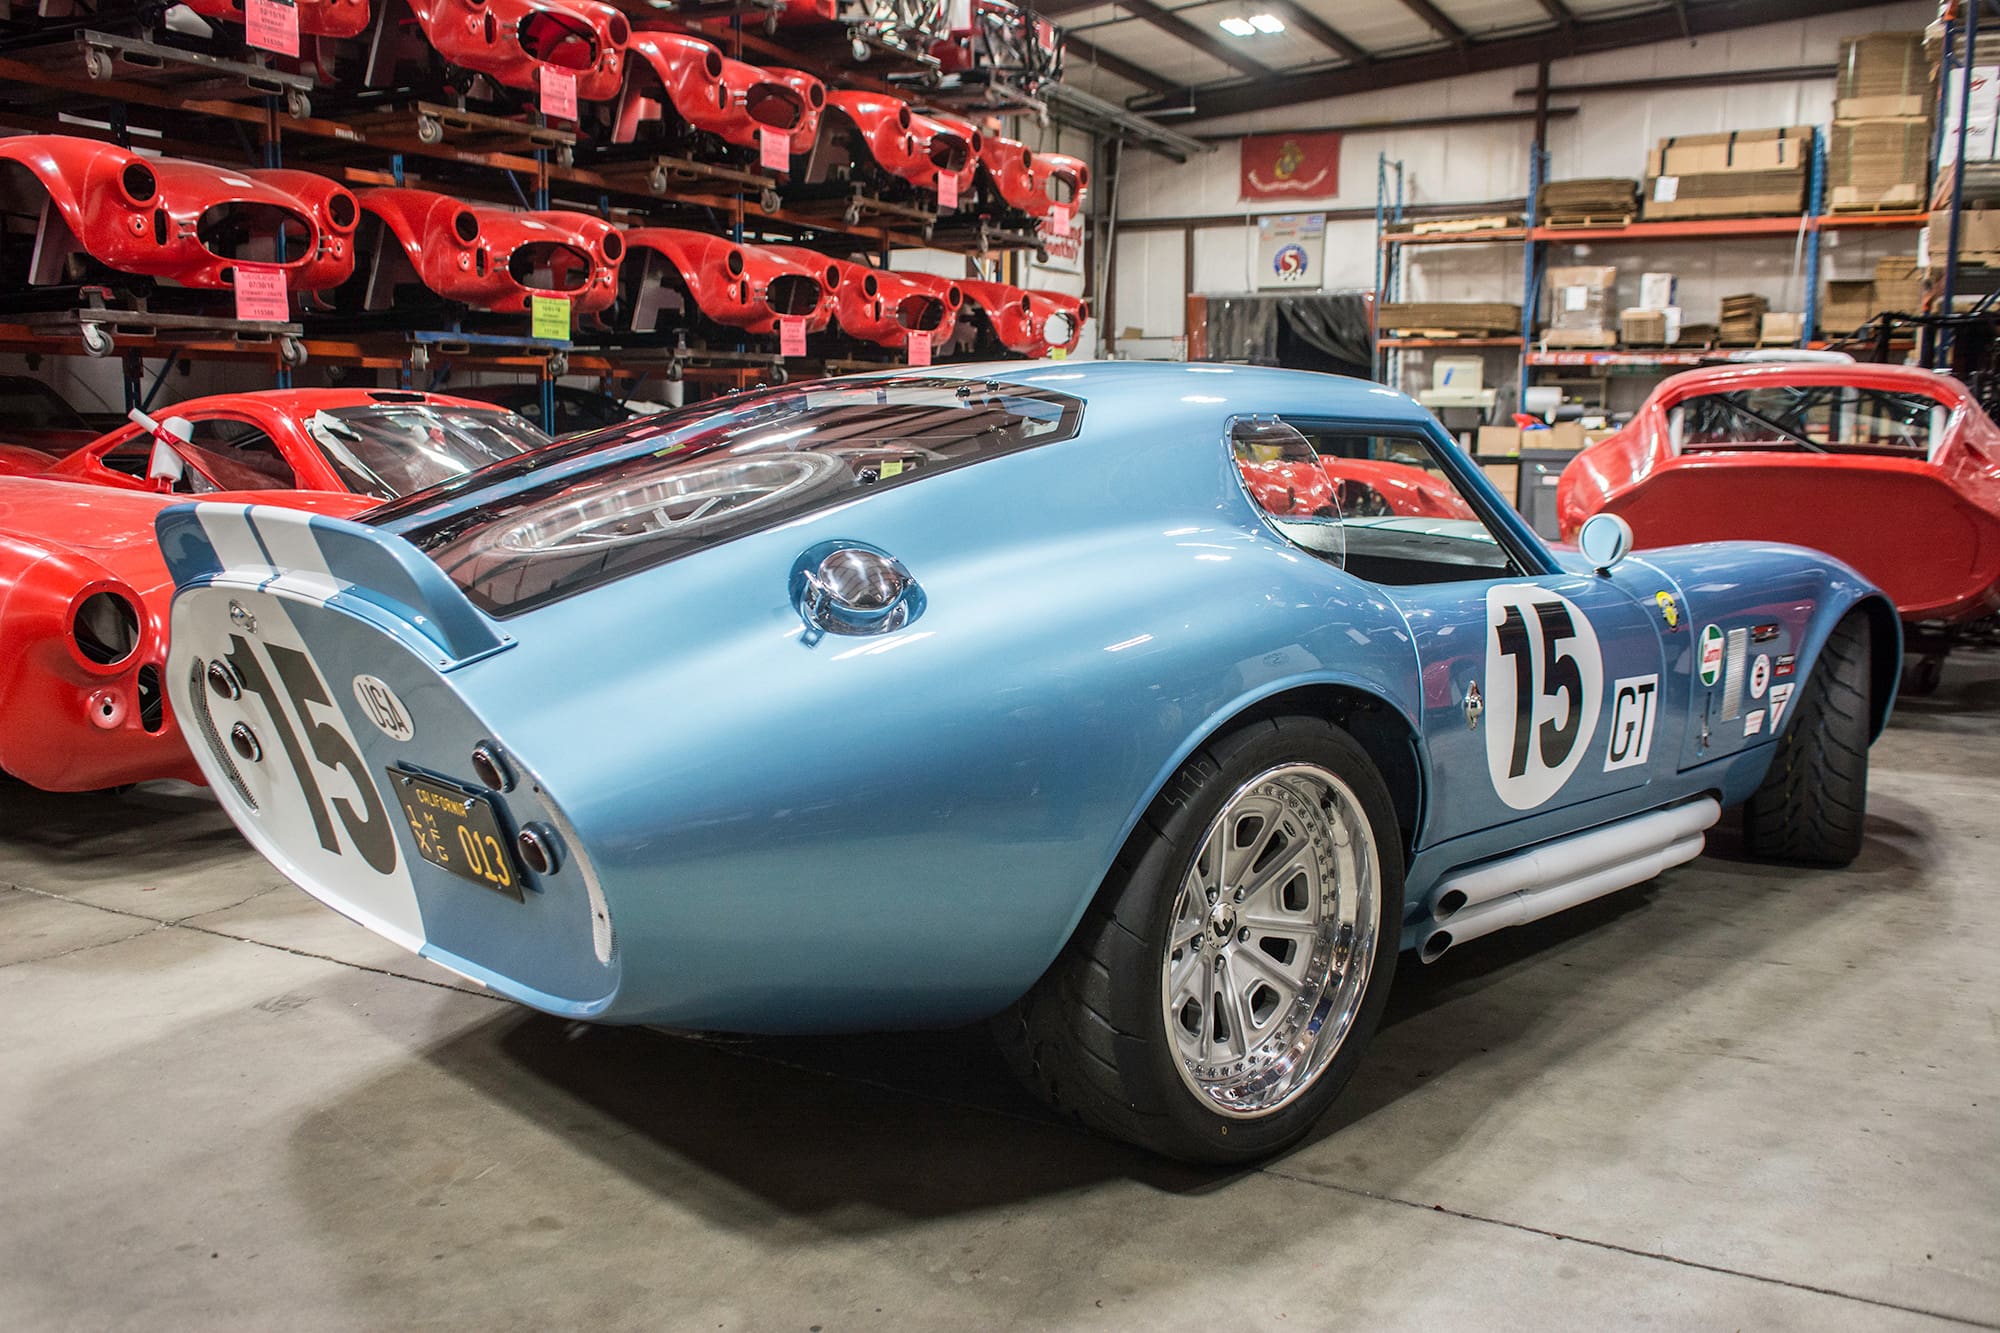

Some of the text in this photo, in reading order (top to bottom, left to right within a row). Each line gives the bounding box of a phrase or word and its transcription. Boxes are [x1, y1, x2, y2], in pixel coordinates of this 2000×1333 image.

[357, 682, 410, 734] USA
[1495, 601, 1583, 778] 15
[1610, 683, 1655, 763] GT
[223, 633, 397, 875] 15
[415, 788, 468, 818] CALIFORNIA
[457, 825, 511, 886] 013
